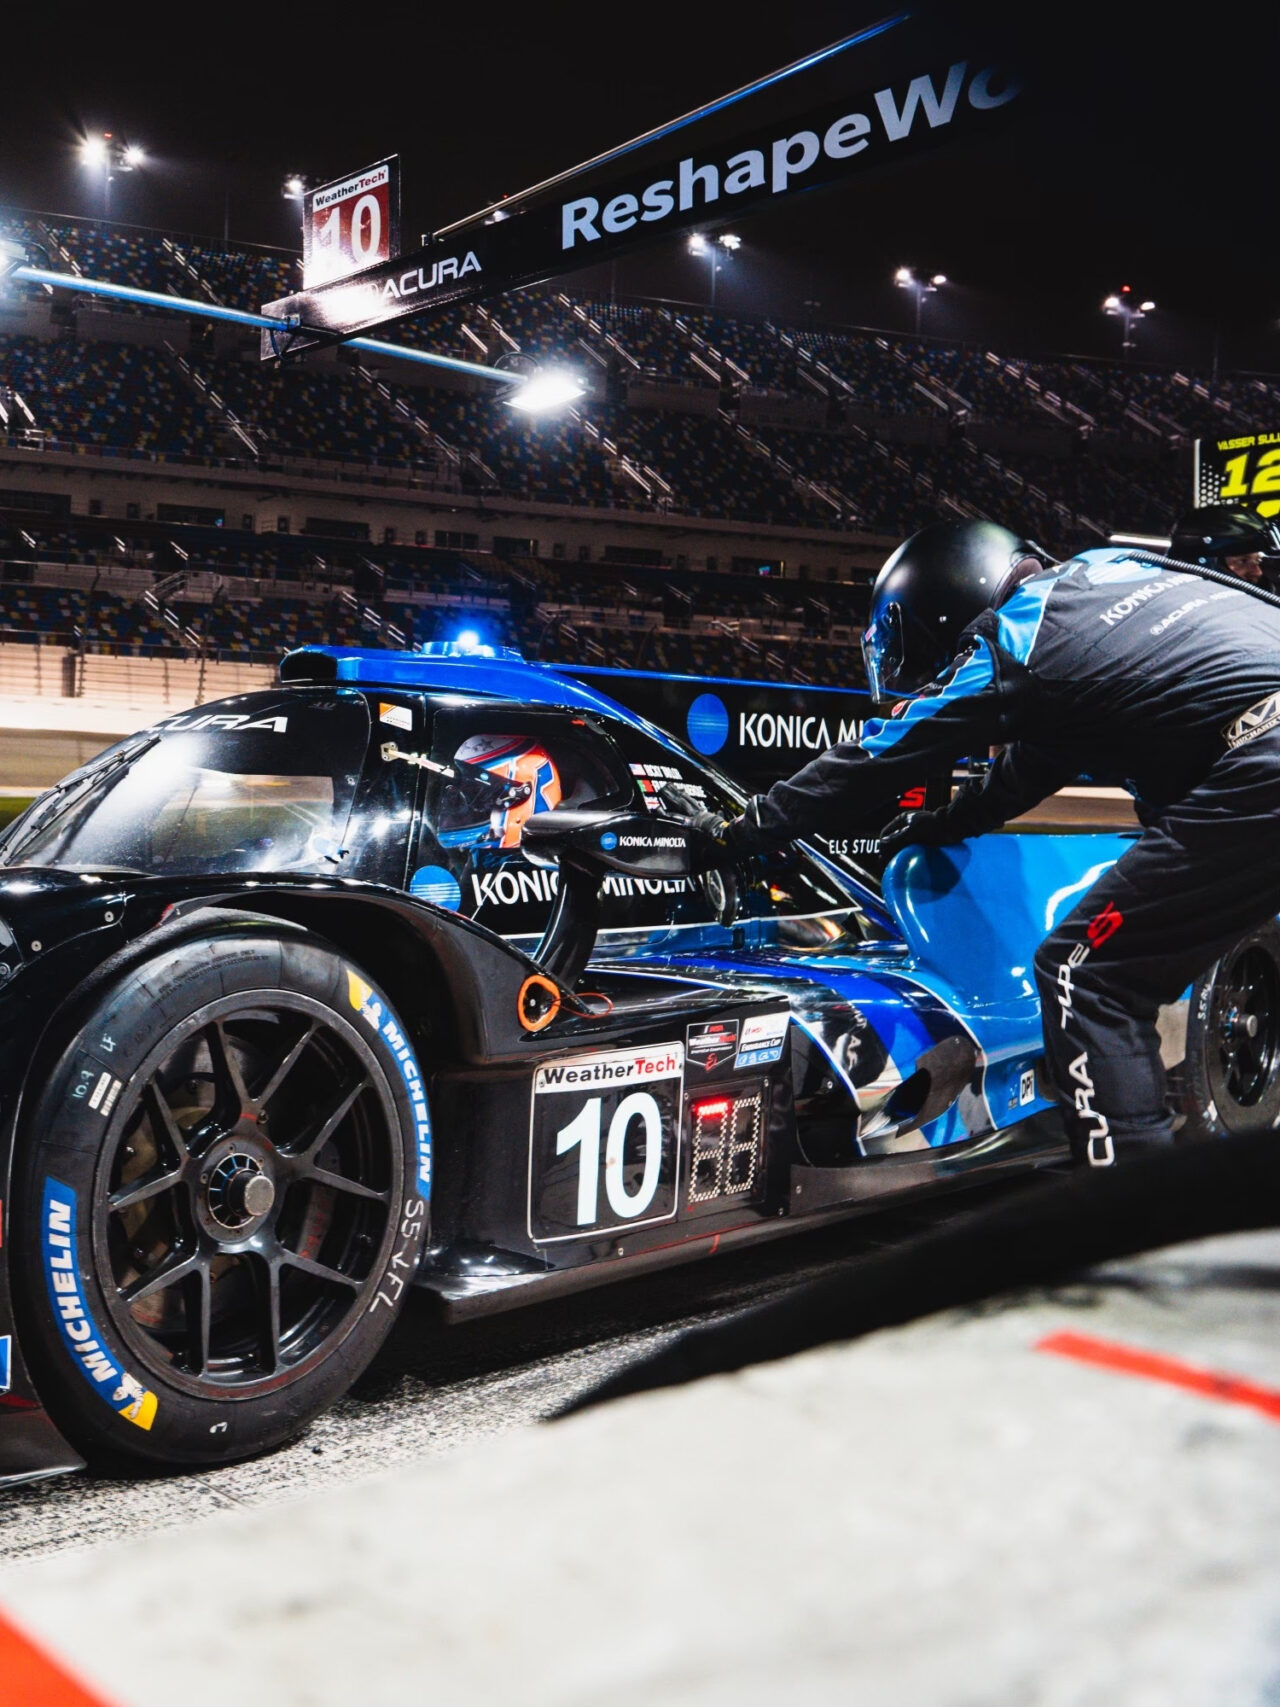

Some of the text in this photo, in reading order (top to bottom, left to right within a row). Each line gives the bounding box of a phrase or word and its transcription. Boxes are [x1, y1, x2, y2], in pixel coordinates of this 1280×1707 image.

[315, 171, 385, 206] WeatherTech
[318, 194, 381, 268] 10
[382, 251, 482, 298] ACURA
[1220, 448, 1280, 497] 12
[1099, 582, 1167, 625] KONICA
[739, 712, 832, 750] KONICA
[619, 836, 686, 848] KONICA MINOLTA
[829, 839, 848, 854] ELS
[543, 1056, 676, 1084] WeatherTech
[382, 1024, 431, 1183] MICHELIN
[556, 1092, 662, 1226] 10
[48, 1199, 118, 1383] MICHELIN
